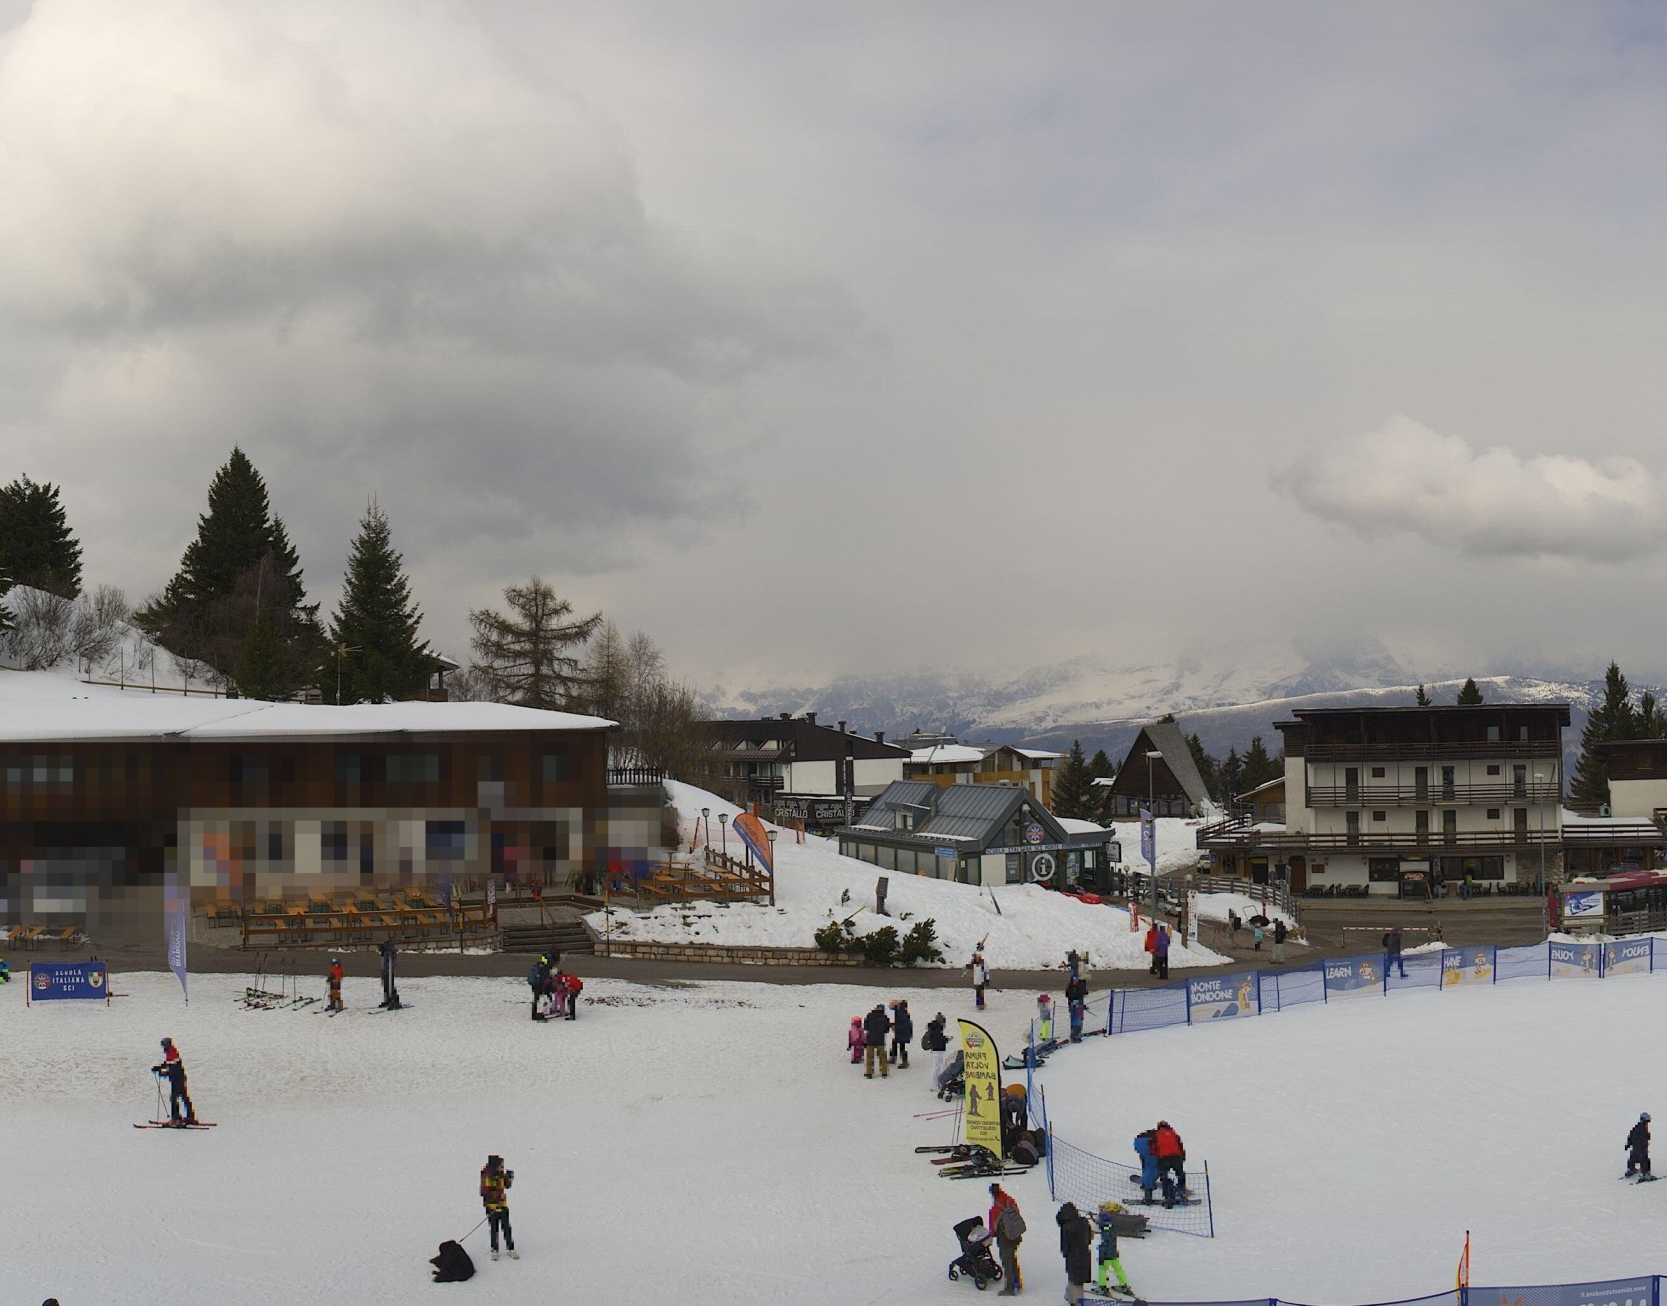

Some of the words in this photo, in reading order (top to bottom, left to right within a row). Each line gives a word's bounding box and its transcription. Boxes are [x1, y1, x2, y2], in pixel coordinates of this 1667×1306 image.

[774, 808, 808, 819] CRSTALLO
[1444, 955, 1461, 967] HAVE
[1551, 949, 1574, 961] ENJOY
[1326, 966, 1352, 979] LEARN
[52, 976, 85, 984] ITALIANA
[1190, 980, 1221, 991] MONTE
[1190, 989, 1233, 1004] BONDONE
